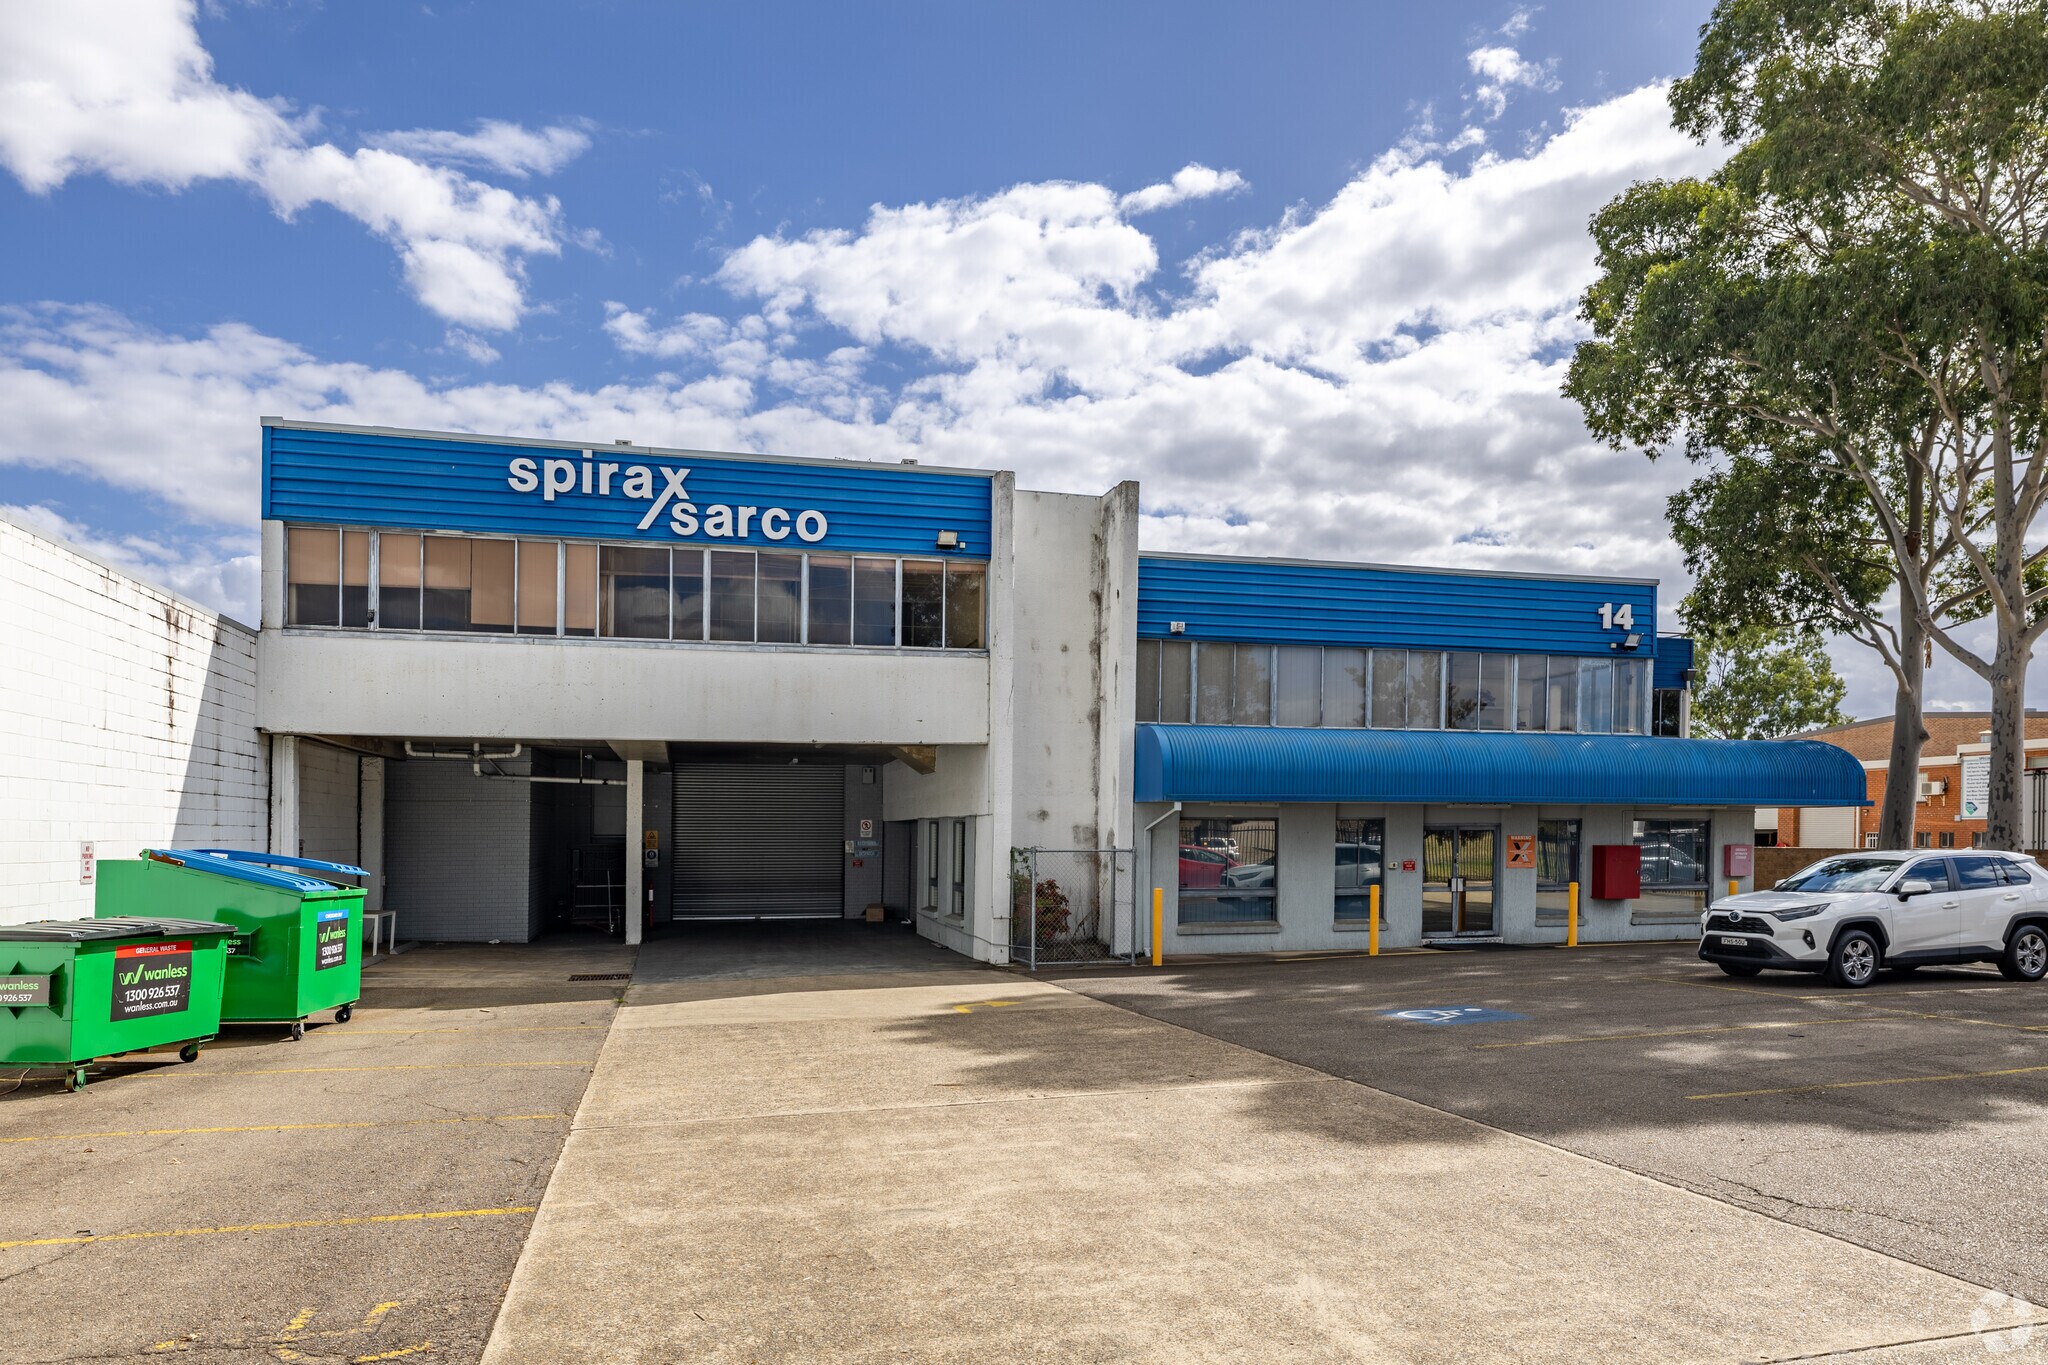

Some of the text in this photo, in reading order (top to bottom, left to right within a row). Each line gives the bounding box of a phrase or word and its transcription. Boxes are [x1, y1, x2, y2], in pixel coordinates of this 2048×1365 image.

[508, 449, 691, 530] spirax
[670, 502, 828, 542] sarco
[1598, 602, 1634, 630] 14
[135, 946, 159, 954] GENERAL
[144, 963, 188, 980] wanless
[3, 994, 18, 1002] 926
[18, 994, 33, 1002] 537
[125, 984, 180, 1002] 1300 926 537
[124, 999, 178, 1013] wanless.com.au
